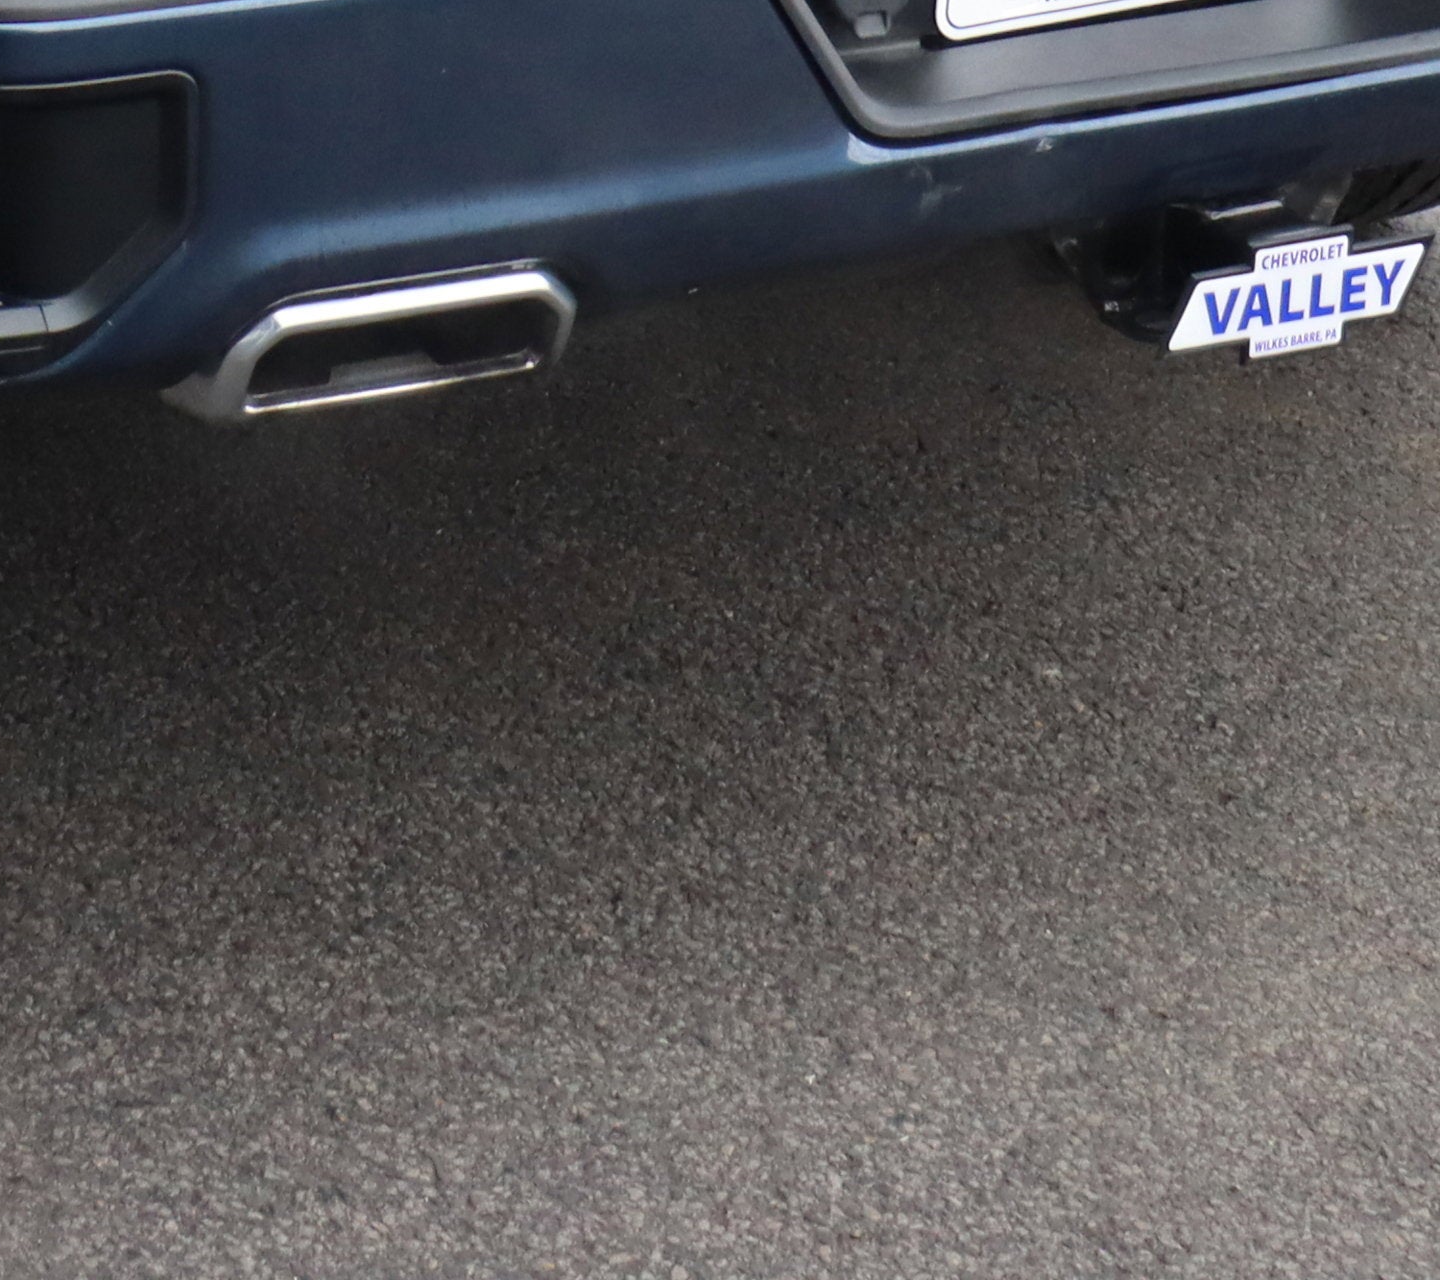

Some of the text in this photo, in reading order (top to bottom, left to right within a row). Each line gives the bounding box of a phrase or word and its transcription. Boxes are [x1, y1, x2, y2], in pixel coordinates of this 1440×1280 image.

[1261, 243, 1344, 271] CHEVROLET
[1203, 259, 1406, 336] VALLEY
[1254, 328, 1337, 353] WILKES BARRE, PA
